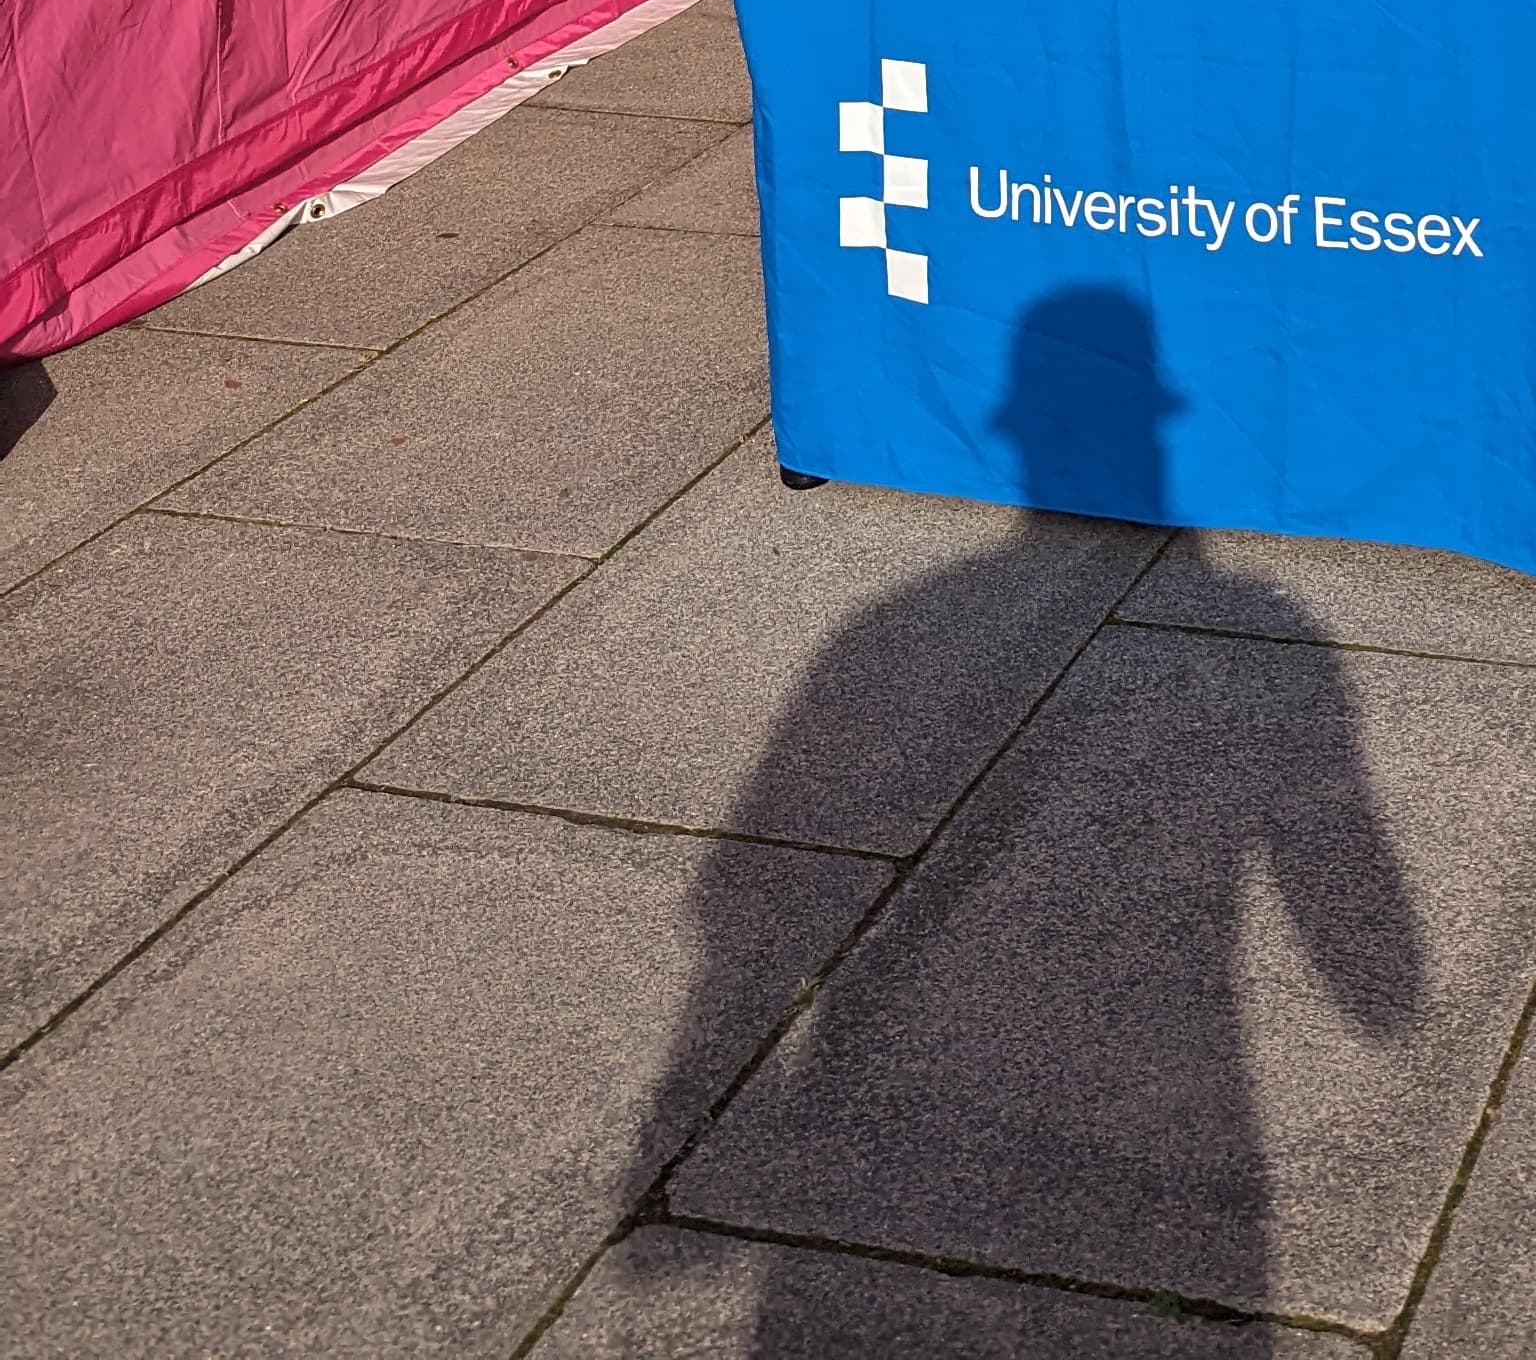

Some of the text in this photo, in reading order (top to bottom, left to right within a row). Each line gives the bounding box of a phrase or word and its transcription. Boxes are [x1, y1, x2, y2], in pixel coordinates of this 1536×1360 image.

[967, 166, 1485, 258] University of Essex
